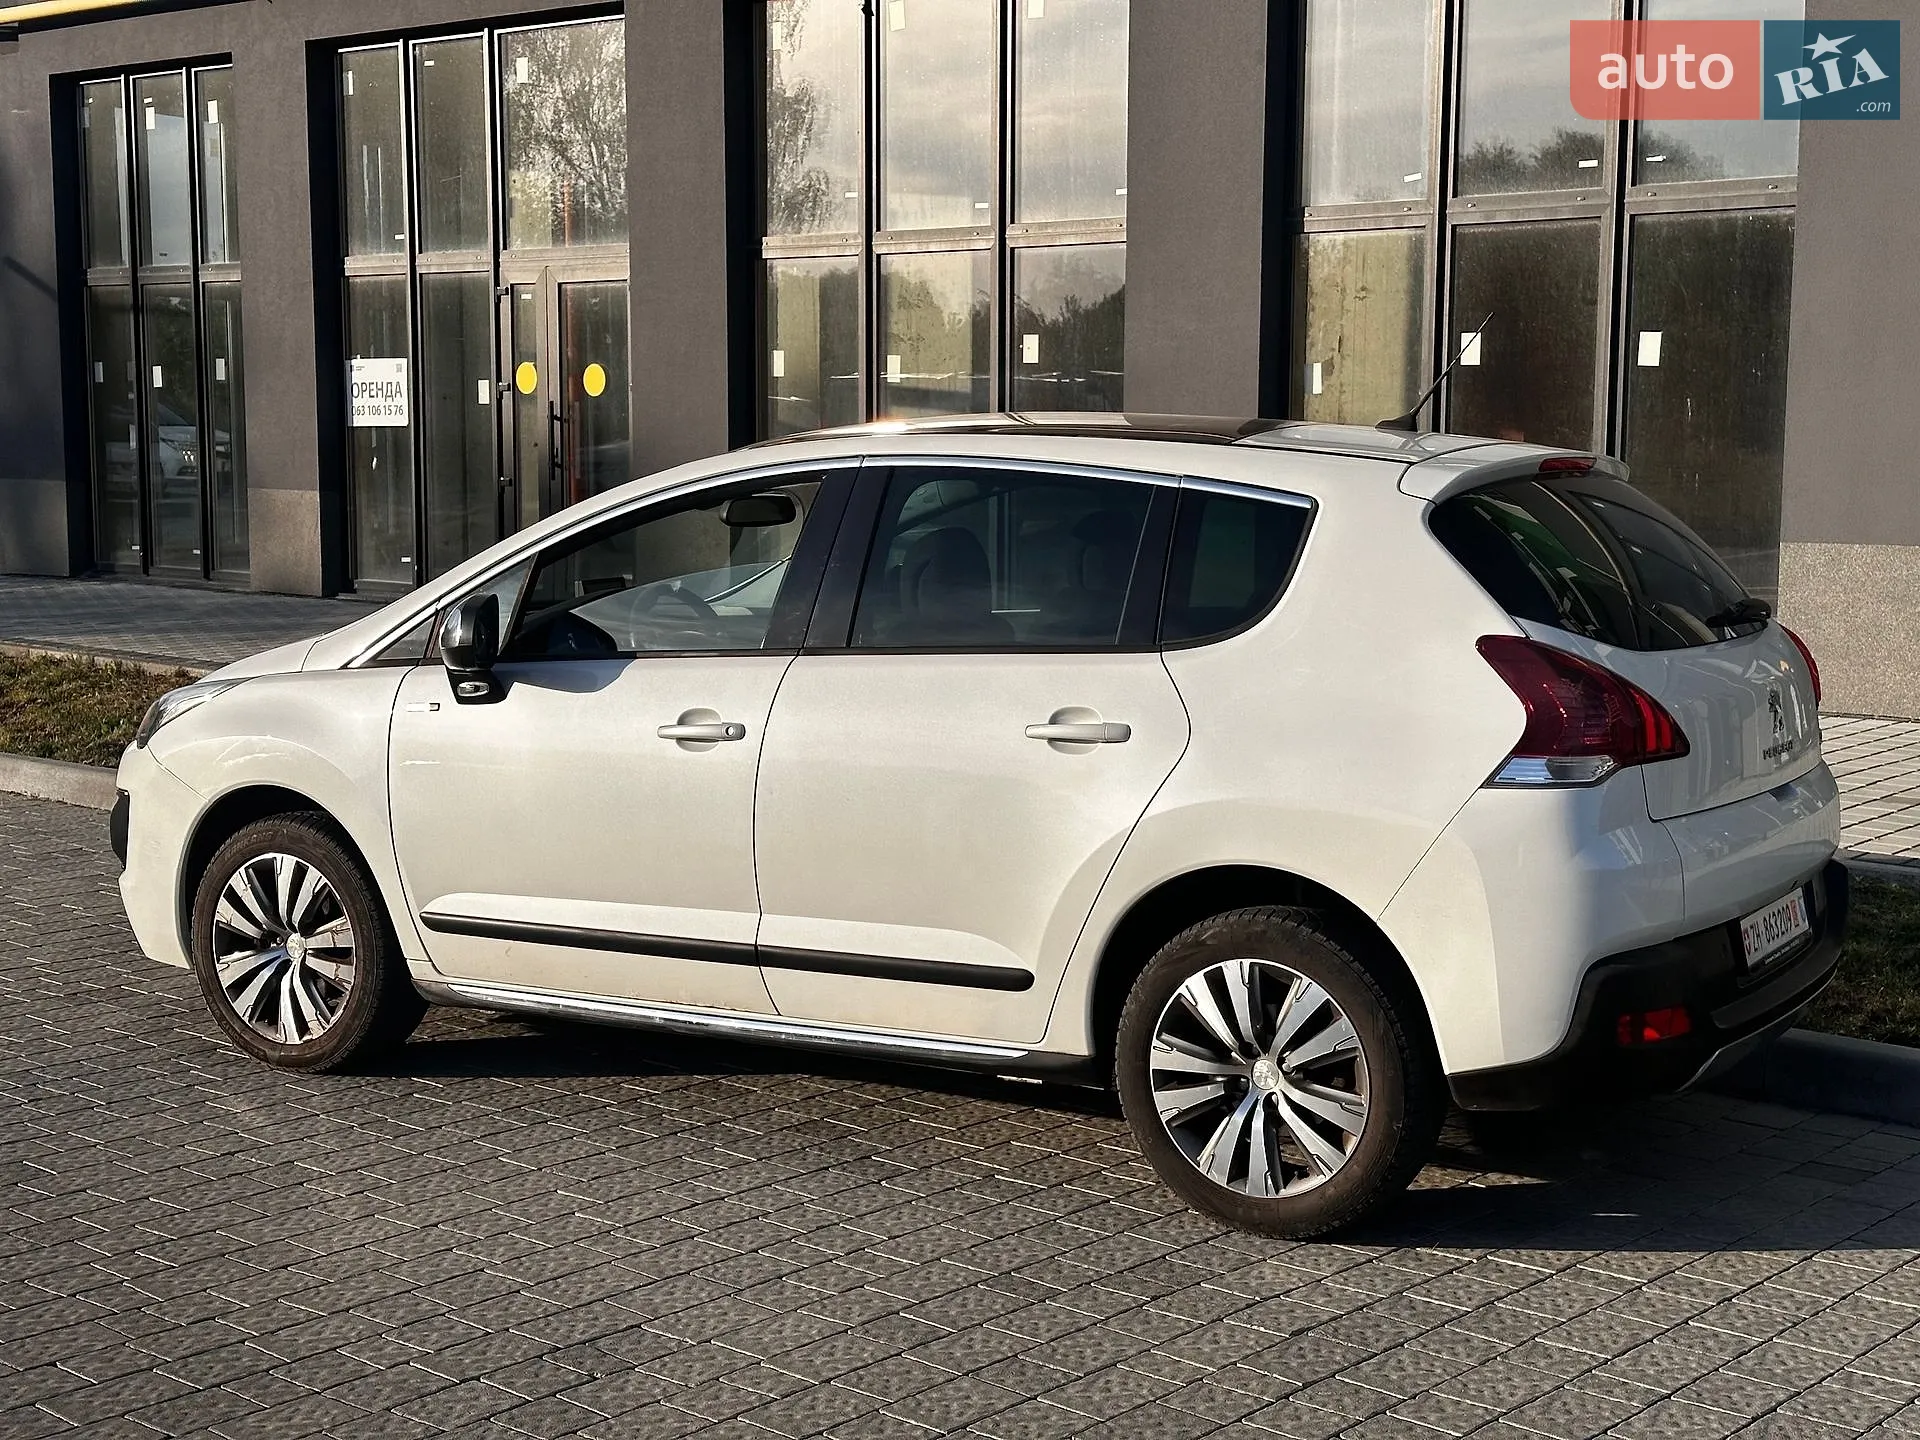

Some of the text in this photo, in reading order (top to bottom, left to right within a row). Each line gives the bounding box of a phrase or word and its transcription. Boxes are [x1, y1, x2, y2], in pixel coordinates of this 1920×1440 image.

[351, 381, 403, 402] ОРЕНДА
[352, 405, 404, 416] 063 106 15 76
